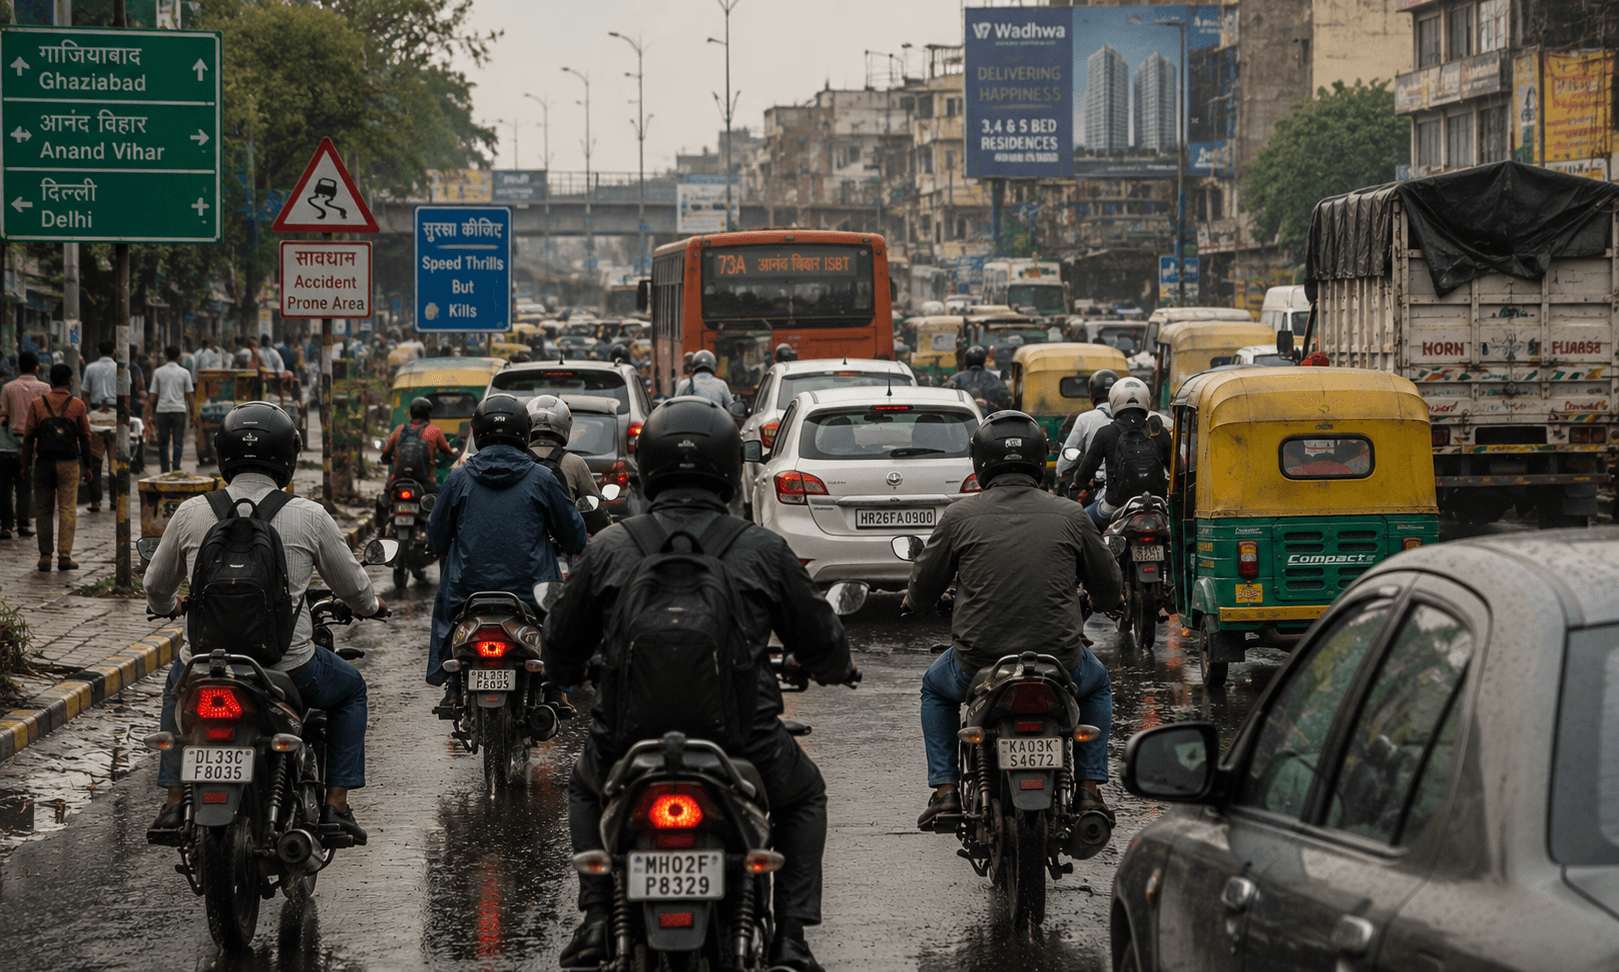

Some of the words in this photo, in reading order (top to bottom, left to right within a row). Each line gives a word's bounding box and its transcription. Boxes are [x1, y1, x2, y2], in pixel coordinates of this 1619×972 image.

[994, 21, 1066, 39] Wadhwa
[38, 39, 142, 66] गाजियाबाद
[977, 65, 1061, 81] DELIVERING
[39, 71, 146, 92] Ghaziabad
[979, 86, 1061, 102] HAPPINESS
[40, 109, 91, 133] आनंद
[97, 109, 148, 134] विहार
[1006, 118, 1016, 133] &
[1031, 118, 1057, 133] BED
[40, 142, 105, 159] Anand
[112, 142, 165, 160] Vihar
[981, 136, 1058, 151] RESIDENCES
[40, 177, 98, 202] दिल्ली
[41, 210, 93, 228] Delhi
[422, 255, 461, 273] Speed
[465, 255, 504, 271] Thrills
[718, 254, 747, 274] 73A
[824, 256, 849, 271] ISBT
[294, 275, 357, 289] Accident
[452, 279, 474, 294] But
[287, 296, 328, 310] Prone
[332, 296, 365, 311] Area
[449, 302, 477, 318] Kills
[1422, 341, 1464, 356] HORN
[860, 511, 933, 525] HR26FA0900
[1010, 740, 1053, 753] KA03K
[195, 750, 243, 764] DL33C
[1011, 753, 1054, 767] S4672
[194, 765, 242, 780] F8035
[645, 855, 709, 874] MH02F
[645, 876, 709, 896] P8329
